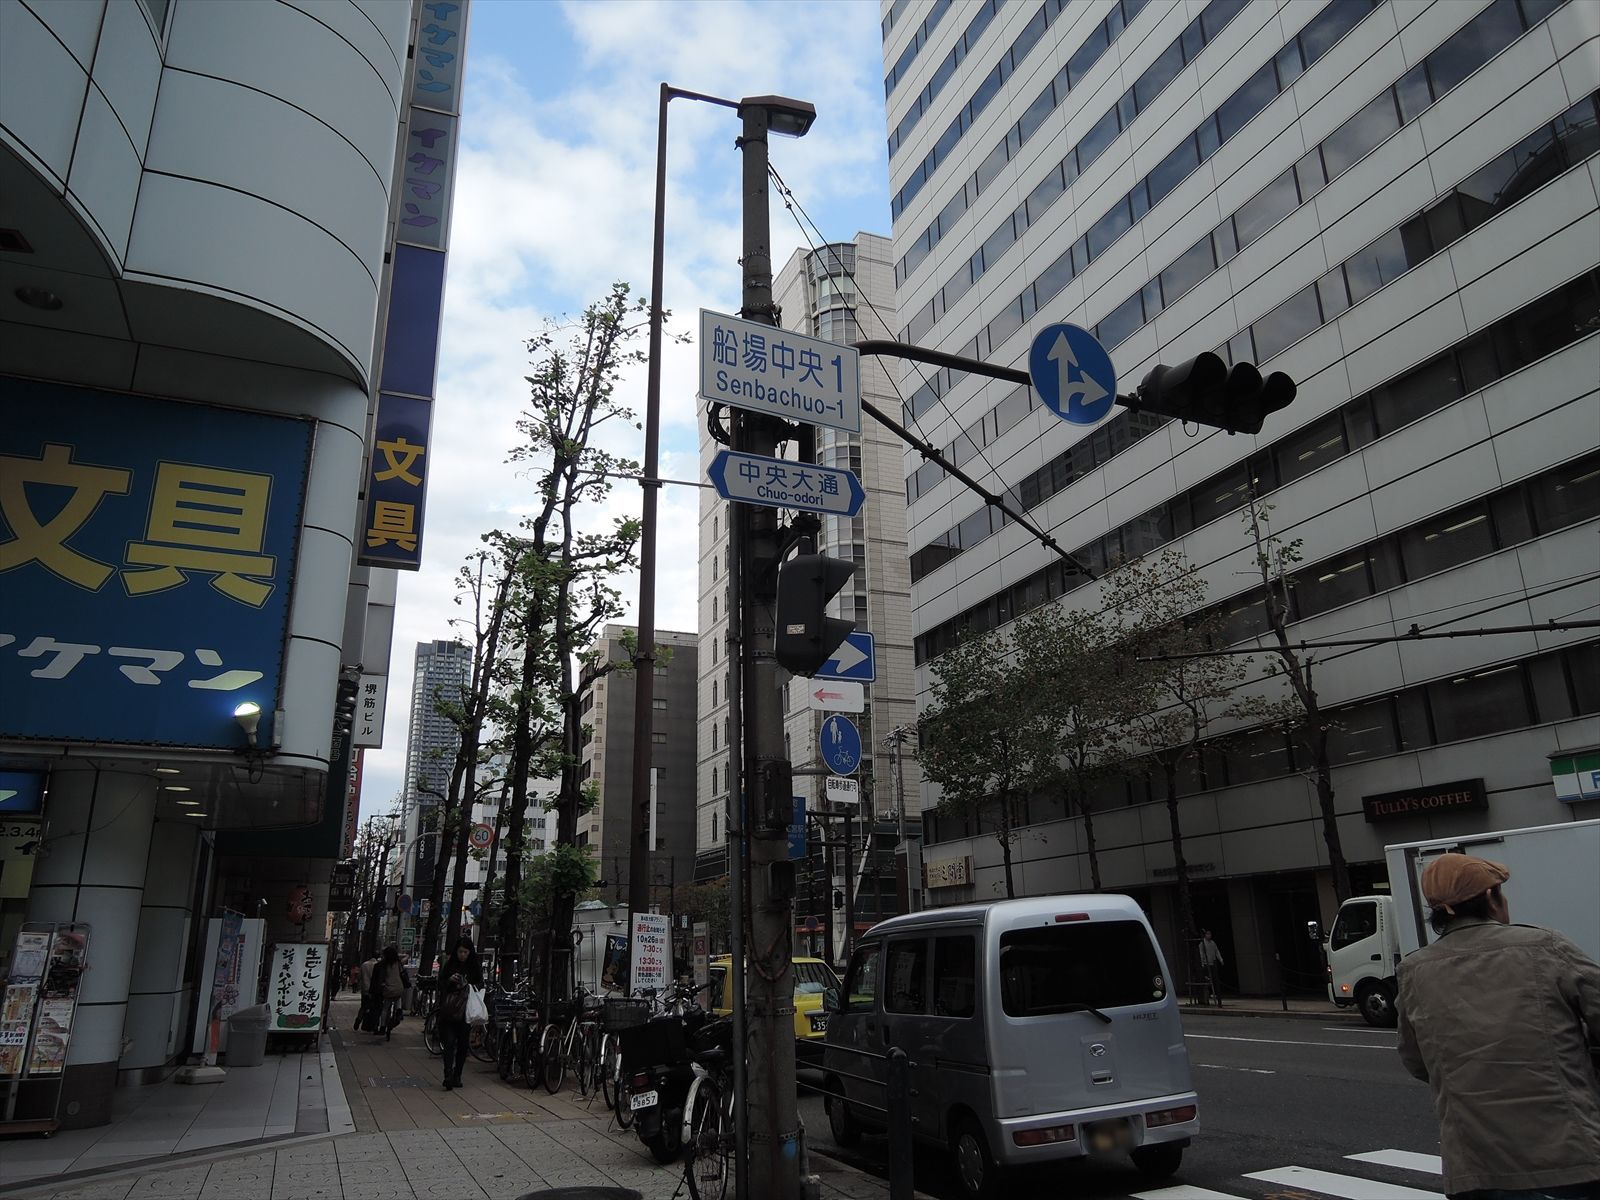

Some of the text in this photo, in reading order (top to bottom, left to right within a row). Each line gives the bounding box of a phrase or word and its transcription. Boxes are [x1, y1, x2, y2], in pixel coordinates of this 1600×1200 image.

[417, 2, 459, 93] イケマン
[401, 127, 447, 228] イケマン
[712, 324, 844, 394] 船場中央1
[716, 370, 844, 419] Senbachuo-1
[366, 437, 425, 552] 文具
[738, 460, 840, 496] 中央大通
[756, 485, 824, 506] Chuo-odori
[0, 441, 278, 609] 文具
[0, 633, 264, 691] ケマン
[361, 683, 377, 736] 堺筋ビル
[1421, 791, 1473, 809] COFFEE
[474, 830, 489, 842] 60
